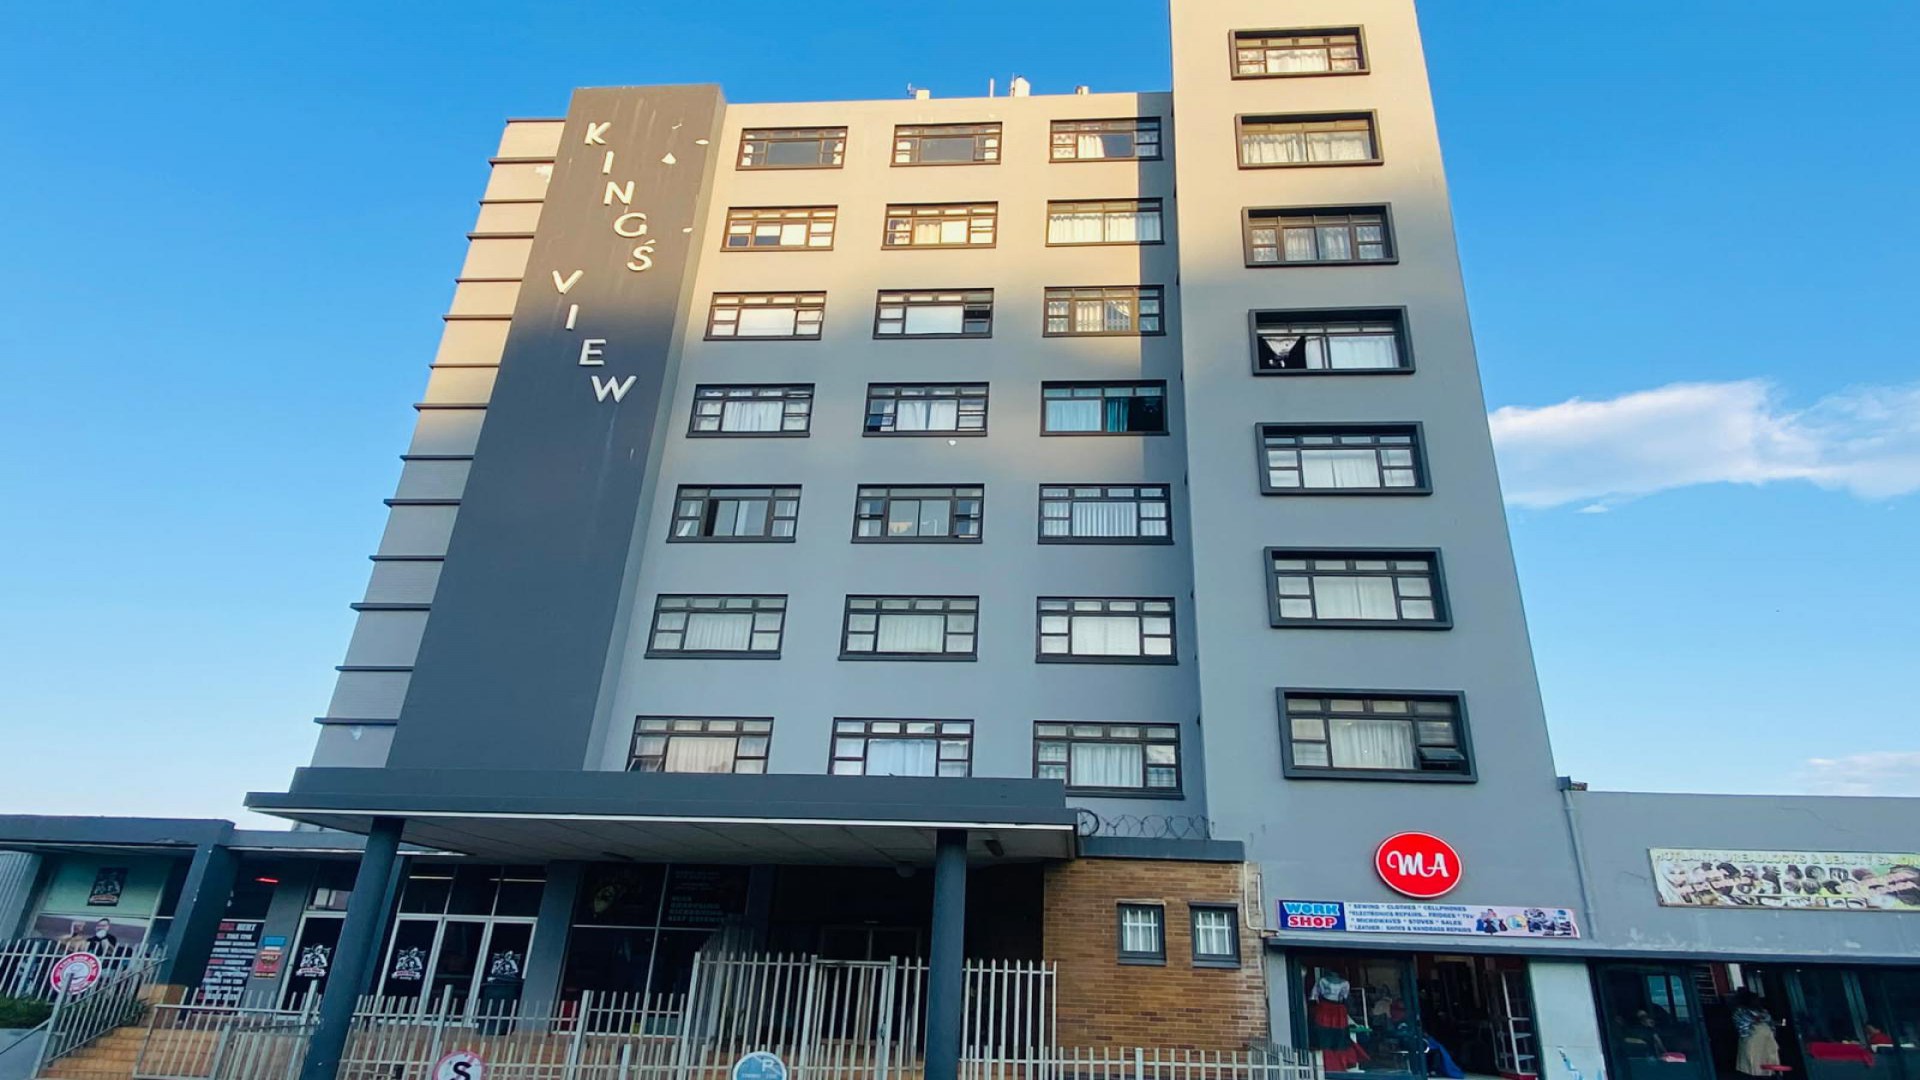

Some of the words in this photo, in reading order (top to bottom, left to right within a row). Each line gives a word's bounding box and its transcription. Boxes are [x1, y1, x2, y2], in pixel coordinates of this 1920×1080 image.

[551, 269, 637, 404] VIEW
[1387, 850, 1450, 879] MA
[1282, 902, 1341, 916] WORK
[1423, 904, 1467, 912] CELLPHONES
[1288, 915, 1337, 929] SHOP
